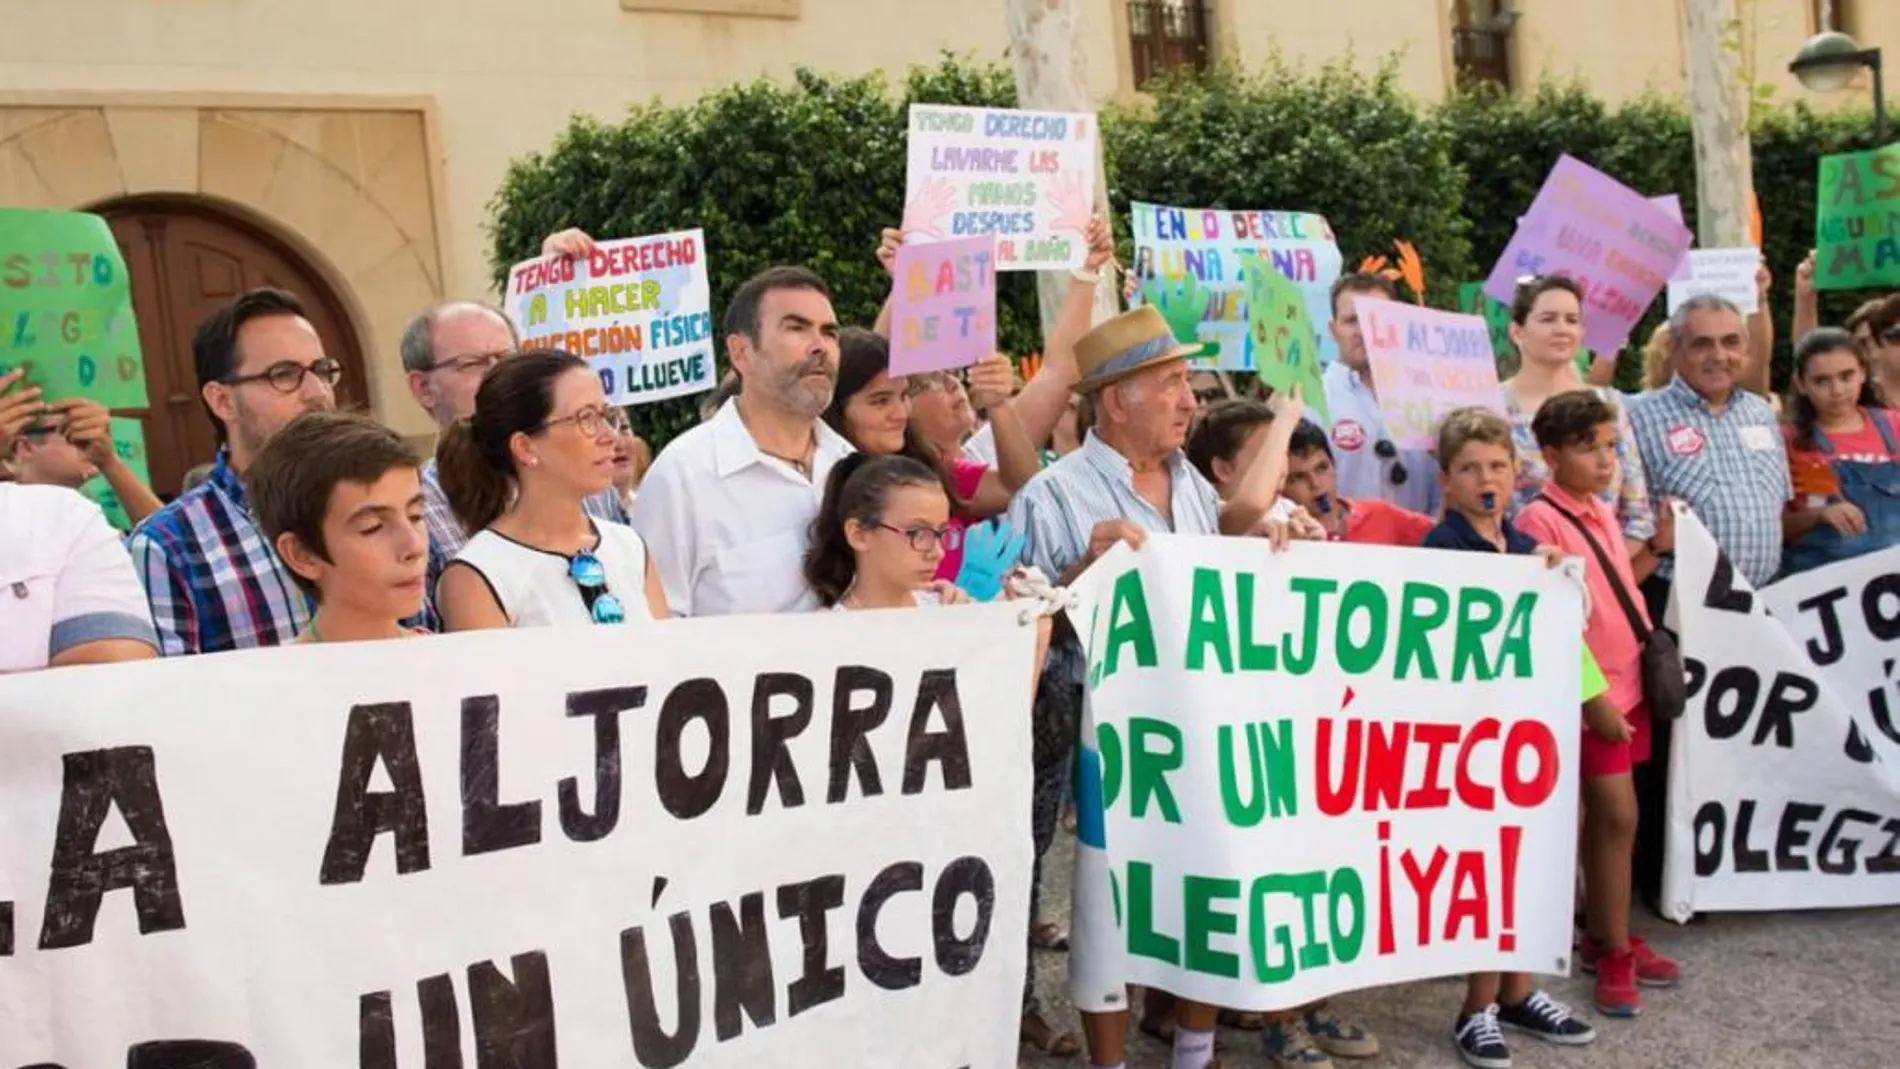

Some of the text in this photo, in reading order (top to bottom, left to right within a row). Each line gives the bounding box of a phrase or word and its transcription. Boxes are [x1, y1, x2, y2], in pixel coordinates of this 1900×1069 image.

[984, 113, 1067, 141] DERECHO
[930, 146, 1060, 174] LAVARME LAS
[967, 181, 1037, 207] MANOS
[514, 237, 697, 294] TENGO DERECHO
[997, 235, 1071, 262] AL BAÑO
[1160, 248, 1223, 282] UNA
[528, 279, 661, 326] A HACER
[627, 353, 705, 393] LLUEVE
[1185, 566, 1539, 682] ALJORRA
[1217, 719, 1299, 828] UN
[1314, 686, 1560, 818] ÚNICO
[0, 665, 973, 950] A ALJORRA
[1109, 820, 1523, 984] LEGIO ¡YA!
[620, 854, 995, 1069] ÚNICO
